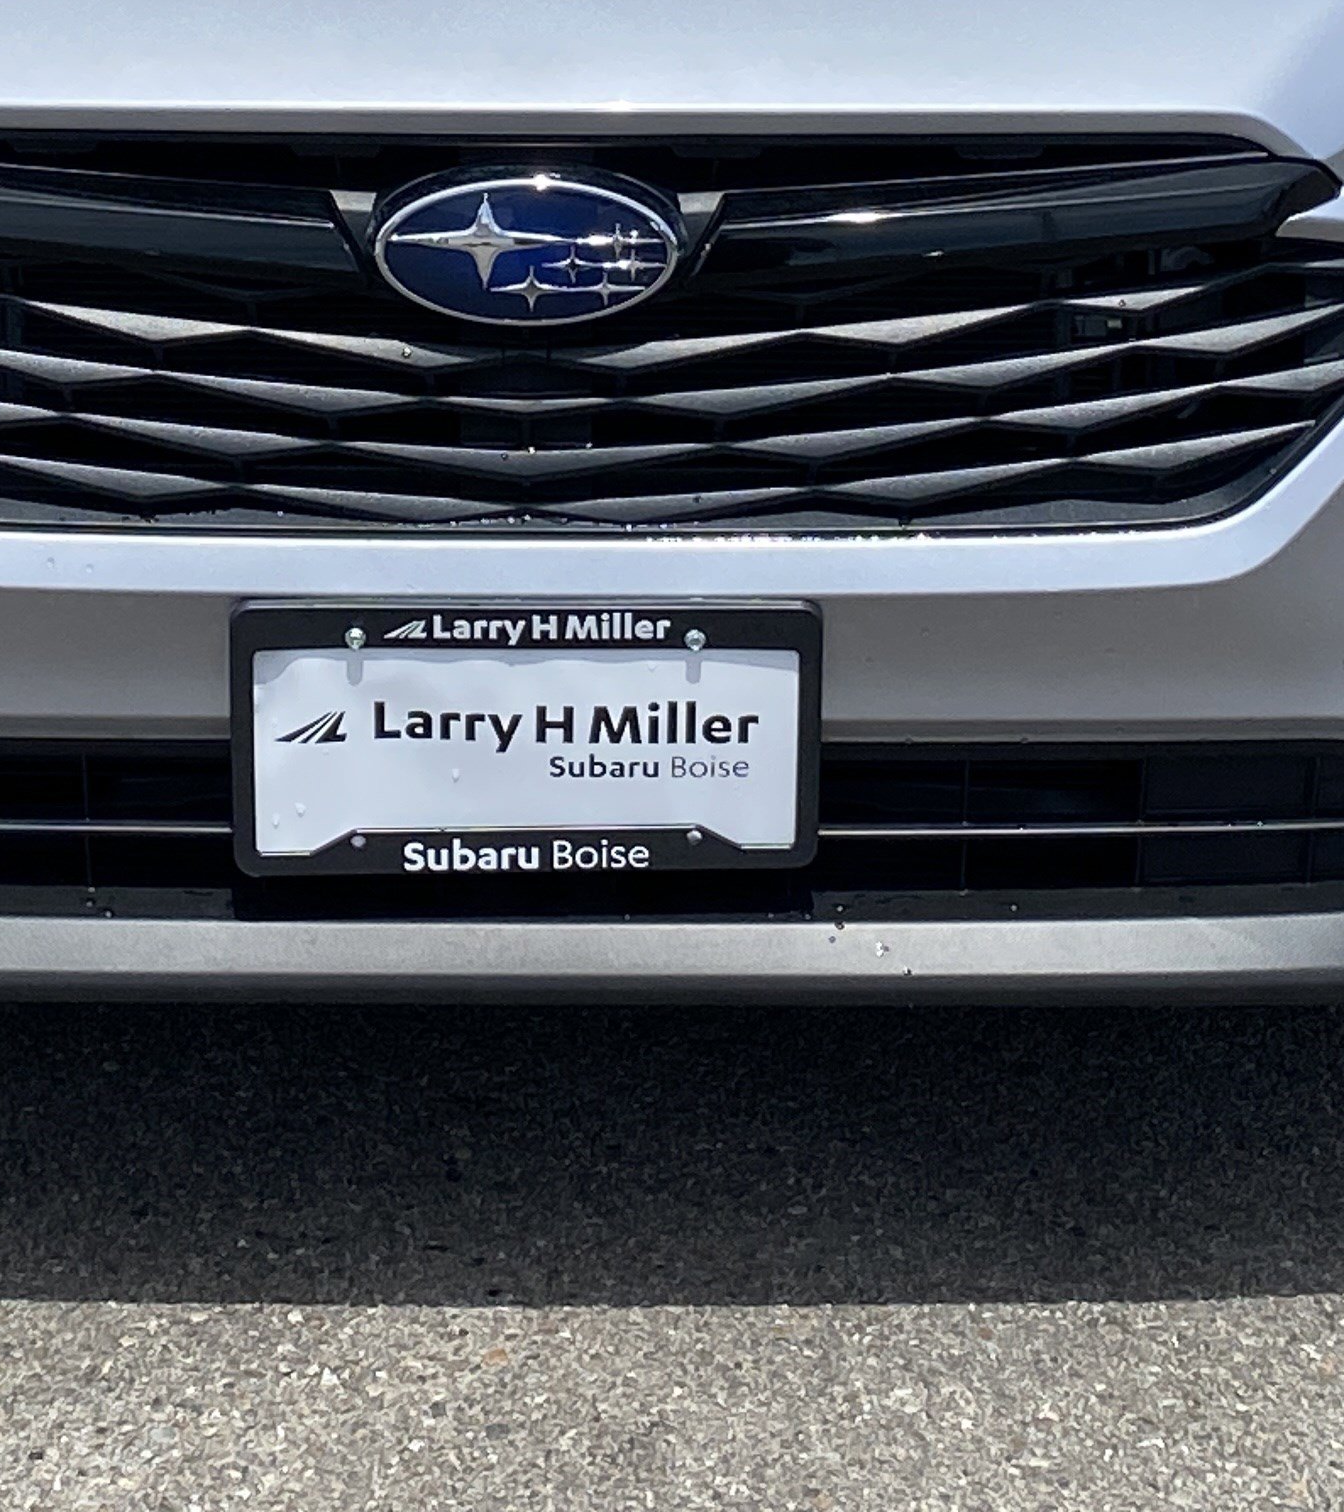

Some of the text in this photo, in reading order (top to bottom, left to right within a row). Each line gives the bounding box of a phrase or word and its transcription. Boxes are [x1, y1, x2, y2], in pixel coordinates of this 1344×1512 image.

[432, 612, 672, 646] Larry H Miller
[373, 699, 760, 753] Larry H Miller
[548, 753, 750, 779] Subaru Boise
[402, 837, 650, 872] Subaru Boise
